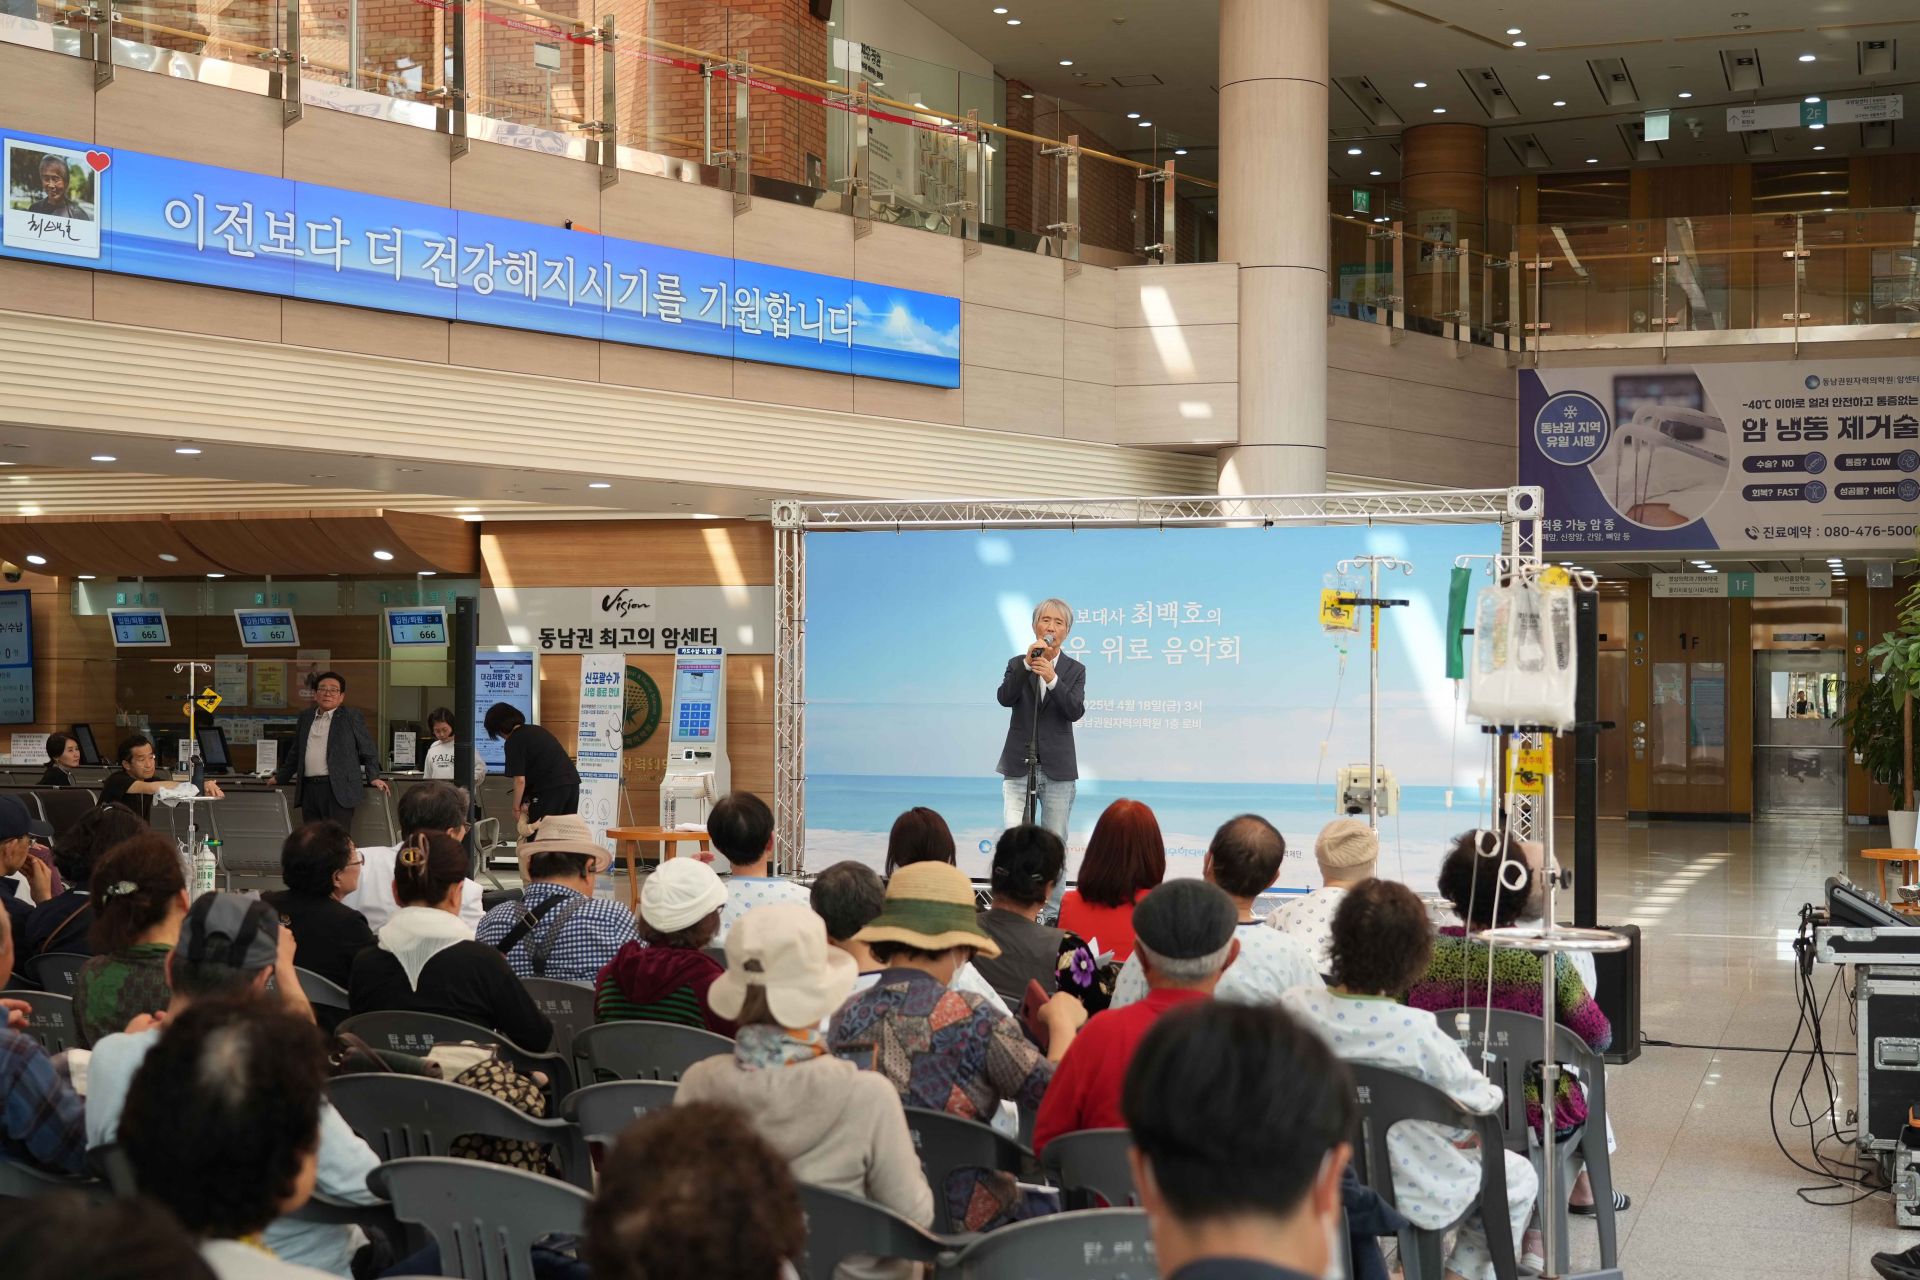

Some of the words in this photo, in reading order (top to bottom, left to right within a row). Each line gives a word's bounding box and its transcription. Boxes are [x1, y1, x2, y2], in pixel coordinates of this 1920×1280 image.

[1806, 107, 1822, 120] 2F
[164, 193, 350, 273] 이전보다
[366, 226, 403, 282] 더
[421, 237, 686, 325] 건강해지시기를
[700, 281, 857, 349] 기원합니다
[1774, 398, 1806, 409] 이하로
[1808, 397, 1829, 409] 얼려
[1832, 396, 1874, 408] 안전하고
[1876, 395, 1919, 407] 통증없는
[1540, 422, 1575, 434] 동남권
[1577, 421, 1601, 433] 지역
[1742, 417, 1768, 443] 암
[1776, 414, 1829, 442] 냉동
[1837, 413, 1919, 441] 제거술
[1546, 436, 1569, 448] 유일
[1572, 435, 1596, 447] 시행
[1756, 459, 1778, 468] 수술?
[1781, 459, 1795, 468] NO
[1845, 458, 1868, 467] 통증?
[1871, 457, 1891, 466] LOW
[1751, 488, 1773, 497] 회복?
[1777, 487, 1799, 497] FAST
[1839, 487, 1869, 496] 성공률?
[1873, 486, 1896, 495] HIGH
[1565, 519, 1588, 531] 가능
[1590, 518, 1601, 531] 암
[1604, 518, 1615, 531] 종
[1763, 526, 1812, 539] 진료예약
[1735, 580, 1749, 591] 1F
[601, 588, 651, 618] Vision
[1073, 607, 1126, 626] 보대사
[1130, 601, 1222, 628] 최백호의
[123, 631, 129, 639] 3
[142, 631, 157, 639] 665
[251, 631, 257, 640] 2
[270, 631, 285, 640] 667
[400, 631, 405, 640] 1
[419, 630, 436, 639] 666
[538, 628, 594, 649] 동남권
[599, 627, 656, 649] 최고의
[661, 627, 718, 648] 암센터
[1061, 635, 1092, 662] 우
[1100, 635, 1153, 664] 위로
[1160, 635, 1241, 666] 음악회
[508, 681, 520, 689] 안내
[1117, 700, 1136, 712] 4월
[1138, 700, 1182, 713] 18일(금)
[1184, 700, 1203, 712] 3시
[1165, 718, 1179, 729] 1층
[1182, 717, 1202, 729] 로비
